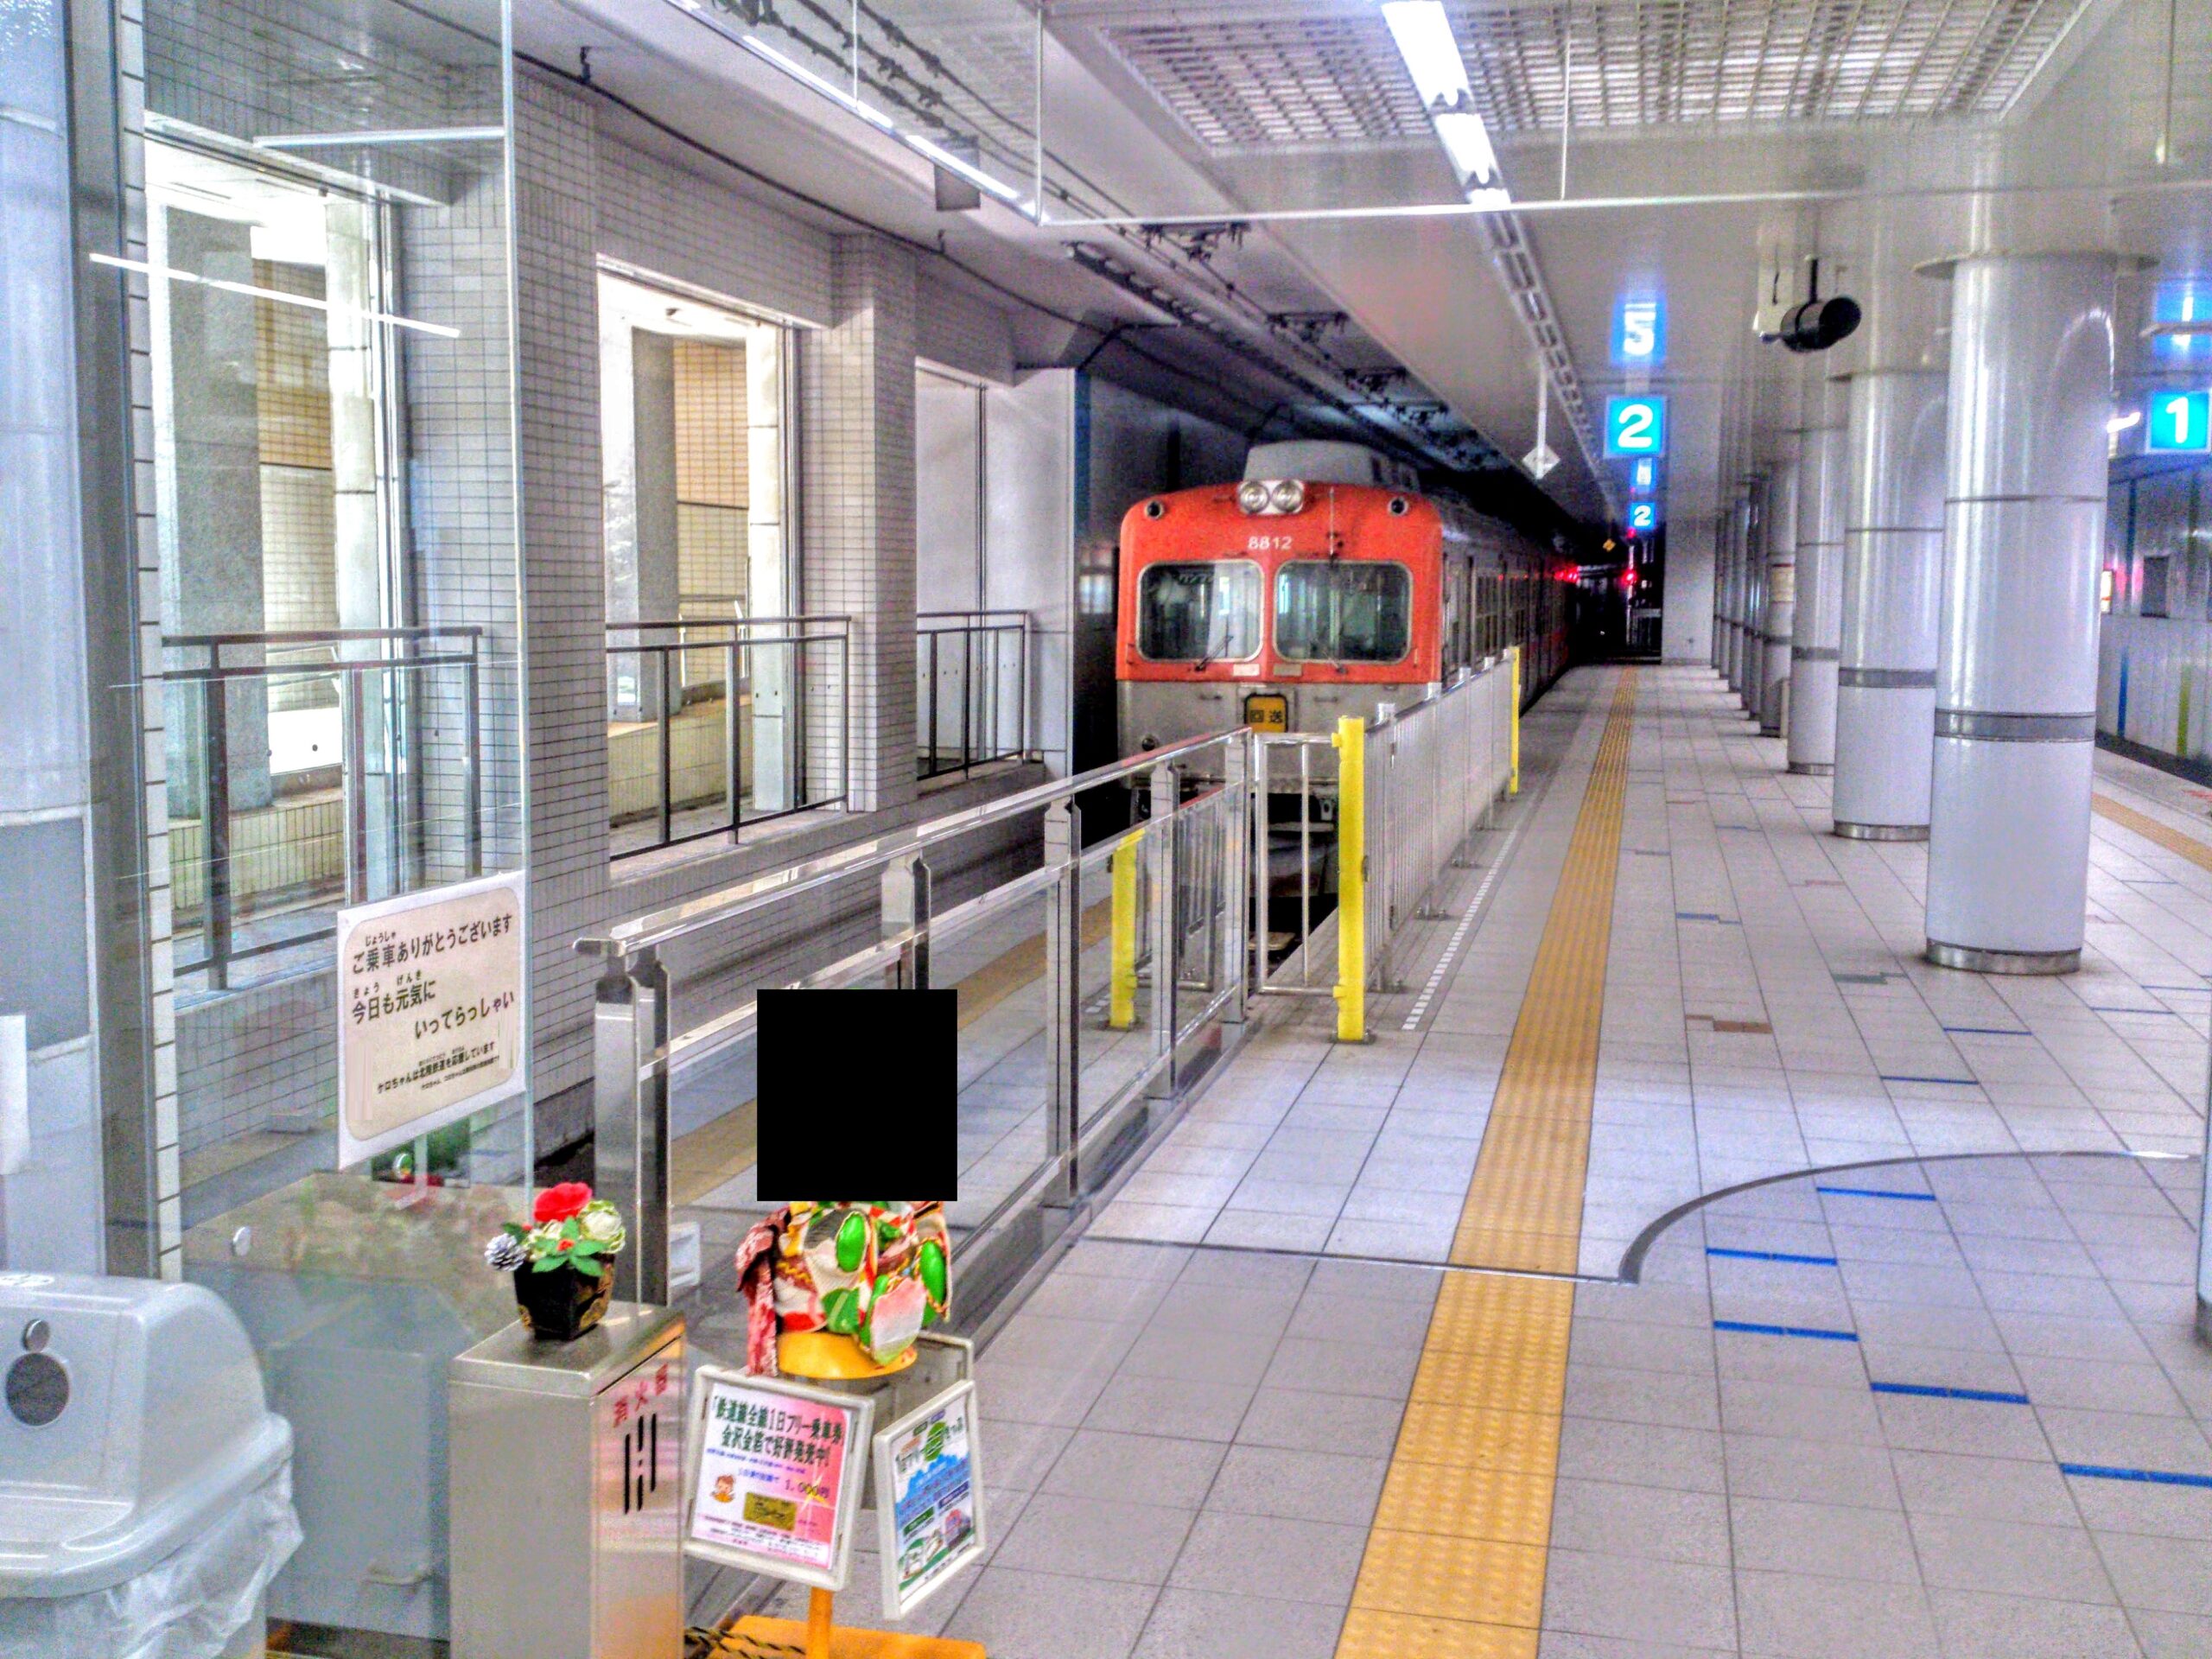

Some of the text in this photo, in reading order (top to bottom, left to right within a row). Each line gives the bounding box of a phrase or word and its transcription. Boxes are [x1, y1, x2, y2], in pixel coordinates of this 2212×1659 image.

[1617, 404, 1654, 448] 2
[2164, 395, 2190, 444] 1
[1633, 505, 1651, 527] 2
[1247, 535, 1293, 550] 8812
[1249, 709, 1283, 723] 回送
[352, 913, 513, 975] ご乗車ありがとうございます
[365, 931, 397, 948] じょうしゃ
[397, 969, 423, 986] げんき
[353, 982, 380, 999] きょう
[352, 979, 437, 1025] 今日も元気に
[415, 991, 515, 1039] いってらっしゃい
